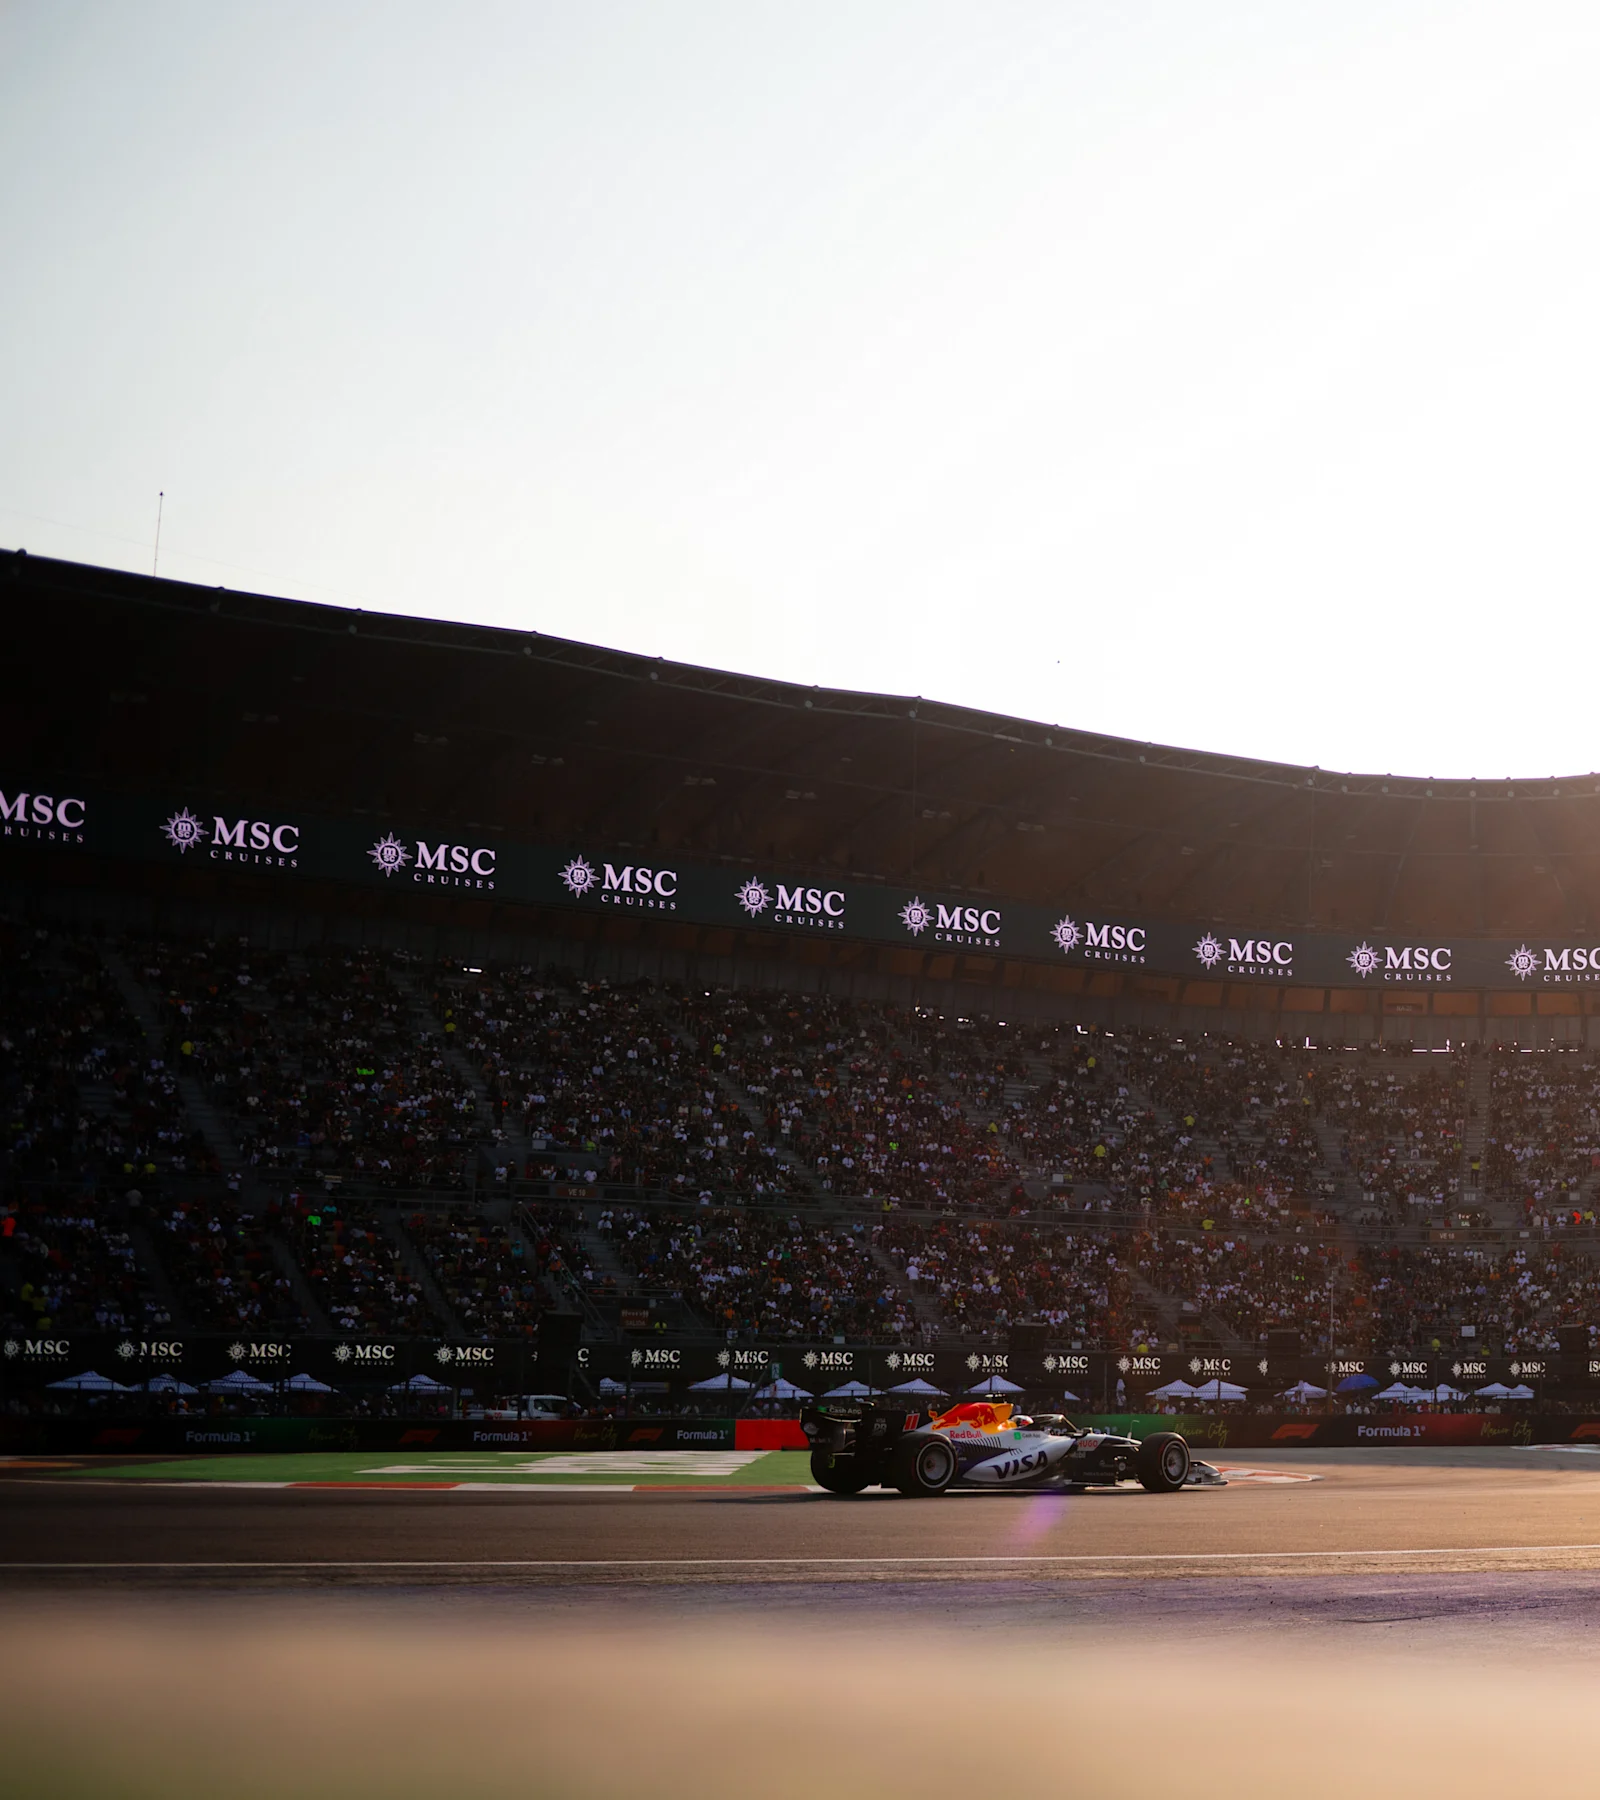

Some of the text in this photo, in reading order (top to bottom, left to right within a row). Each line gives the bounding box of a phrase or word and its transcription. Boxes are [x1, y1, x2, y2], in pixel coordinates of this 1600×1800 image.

[0, 790, 85, 828] MSC
[4, 825, 83, 843] RUISES
[211, 816, 299, 853] MSC
[209, 849, 298, 868] CRUISES
[415, 841, 496, 876] MSC
[413, 872, 496, 890] CRUISES
[602, 864, 677, 897] MSC
[601, 893, 677, 910] CRUISES
[775, 884, 845, 916] MSC
[774, 914, 845, 930] CRUISES
[935, 904, 1000, 934] MSC
[934, 932, 1001, 948] CRUISES
[1084, 922, 1146, 952] MSC
[1084, 949, 1146, 964] CRUISES
[1228, 938, 1293, 965] MSC
[1384, 946, 1451, 970] MSC
[1227, 965, 1293, 977] CRUISES
[1384, 972, 1452, 982] CRUISES
[24, 1339, 70, 1354] MSC
[249, 1343, 292, 1358] MSC
[354, 1345, 396, 1359] MSC
[455, 1347, 495, 1361] MSC
[645, 1349, 681, 1363] MSC
[735, 1350, 769, 1364] MSC
[820, 1352, 853, 1365] MSC
[902, 1353, 935, 1366] MSC
[1059, 1356, 1088, 1368] MSC
[1132, 1357, 1161, 1369] MSC
[1203, 1358, 1231, 1371] MSC
[1338, 1361, 1364, 1372] MSC
[1402, 1362, 1427, 1373] MSC
[1463, 1362, 1486, 1374] MSC
[186, 1431, 240, 1442] Formula
[473, 1431, 518, 1442] Formula
[676, 1429, 719, 1440] Formula
[950, 1431, 966, 1439] Red
[1357, 1425, 1410, 1437] Formula
[1079, 1440, 1098, 1448] HUGO
[988, 1451, 1048, 1479] VISA
